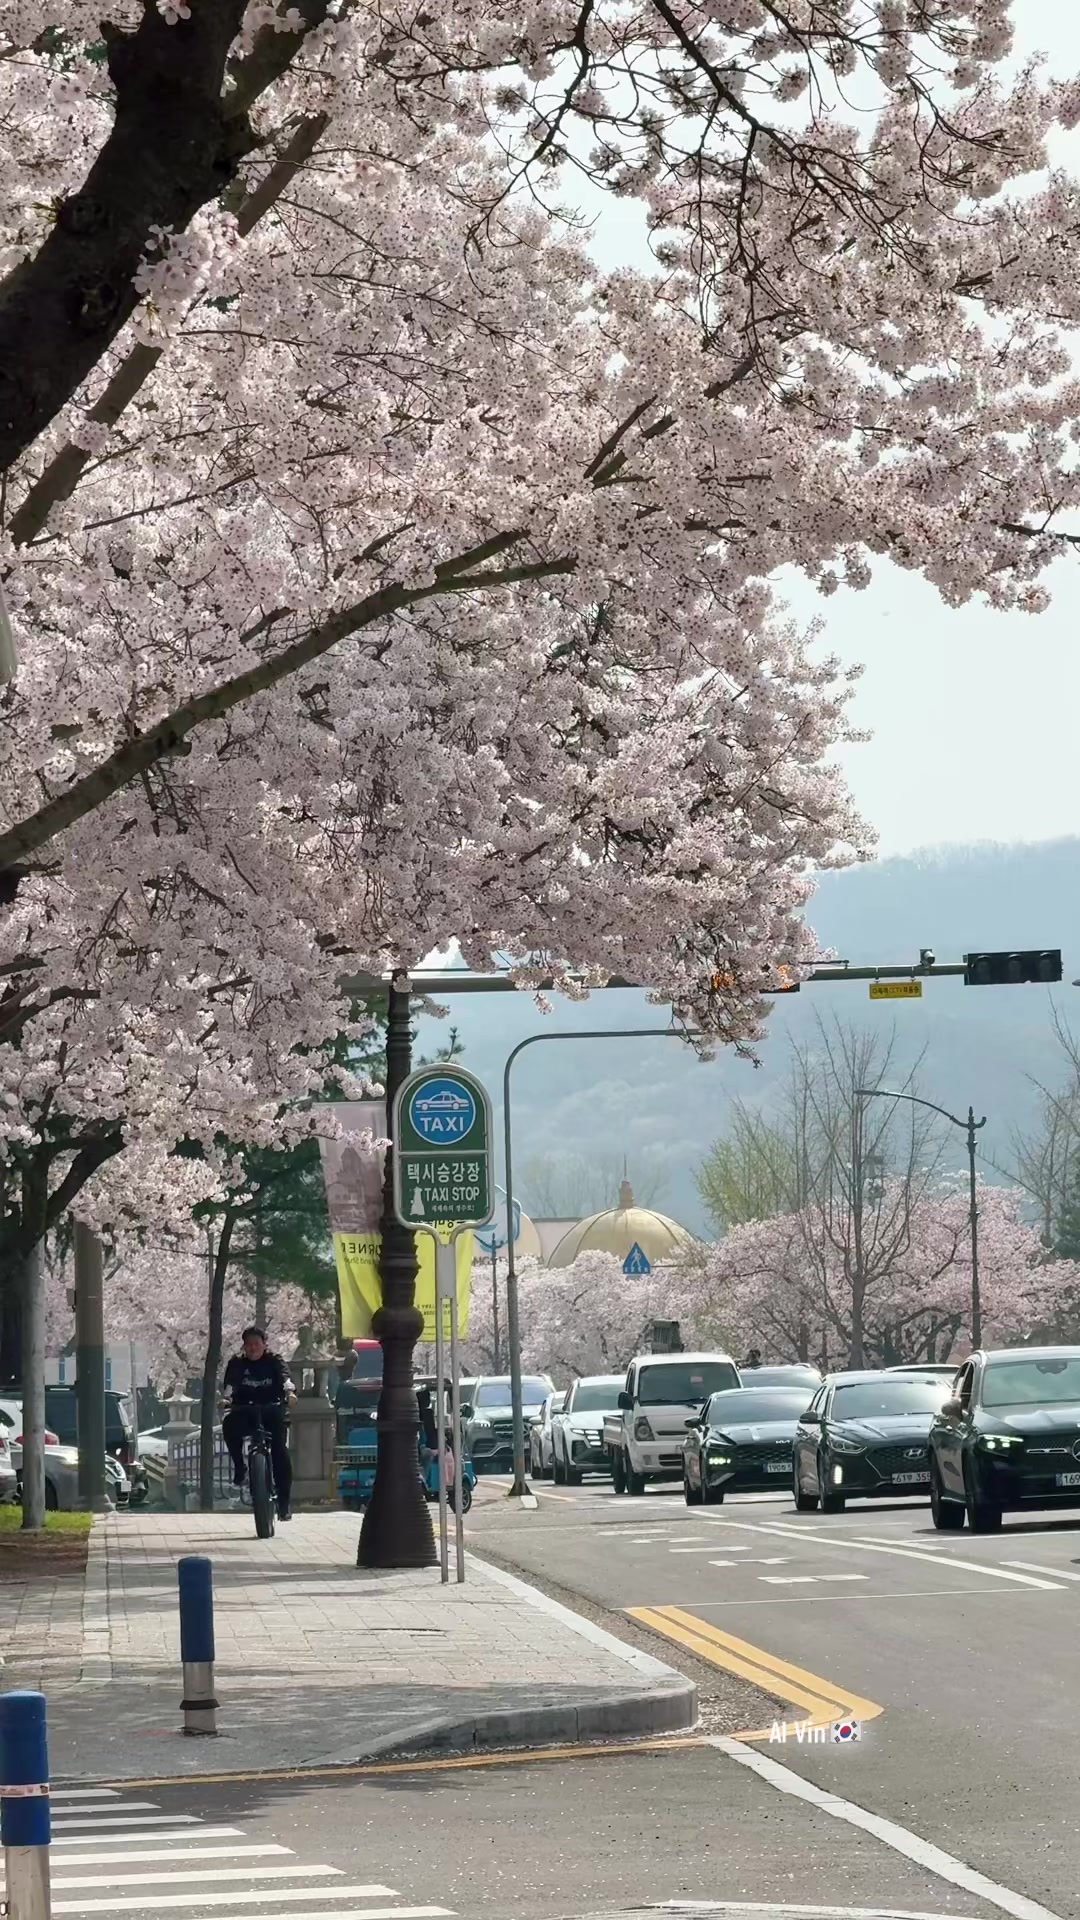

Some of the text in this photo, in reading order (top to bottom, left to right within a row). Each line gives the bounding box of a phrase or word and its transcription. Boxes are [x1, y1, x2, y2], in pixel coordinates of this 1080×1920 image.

[420, 1116, 464, 1133] TAXI
[407, 1162, 480, 1184] 택시승강장
[424, 1186, 480, 1202] TAXI STOP
[1064, 1473, 1080, 1485] 169
